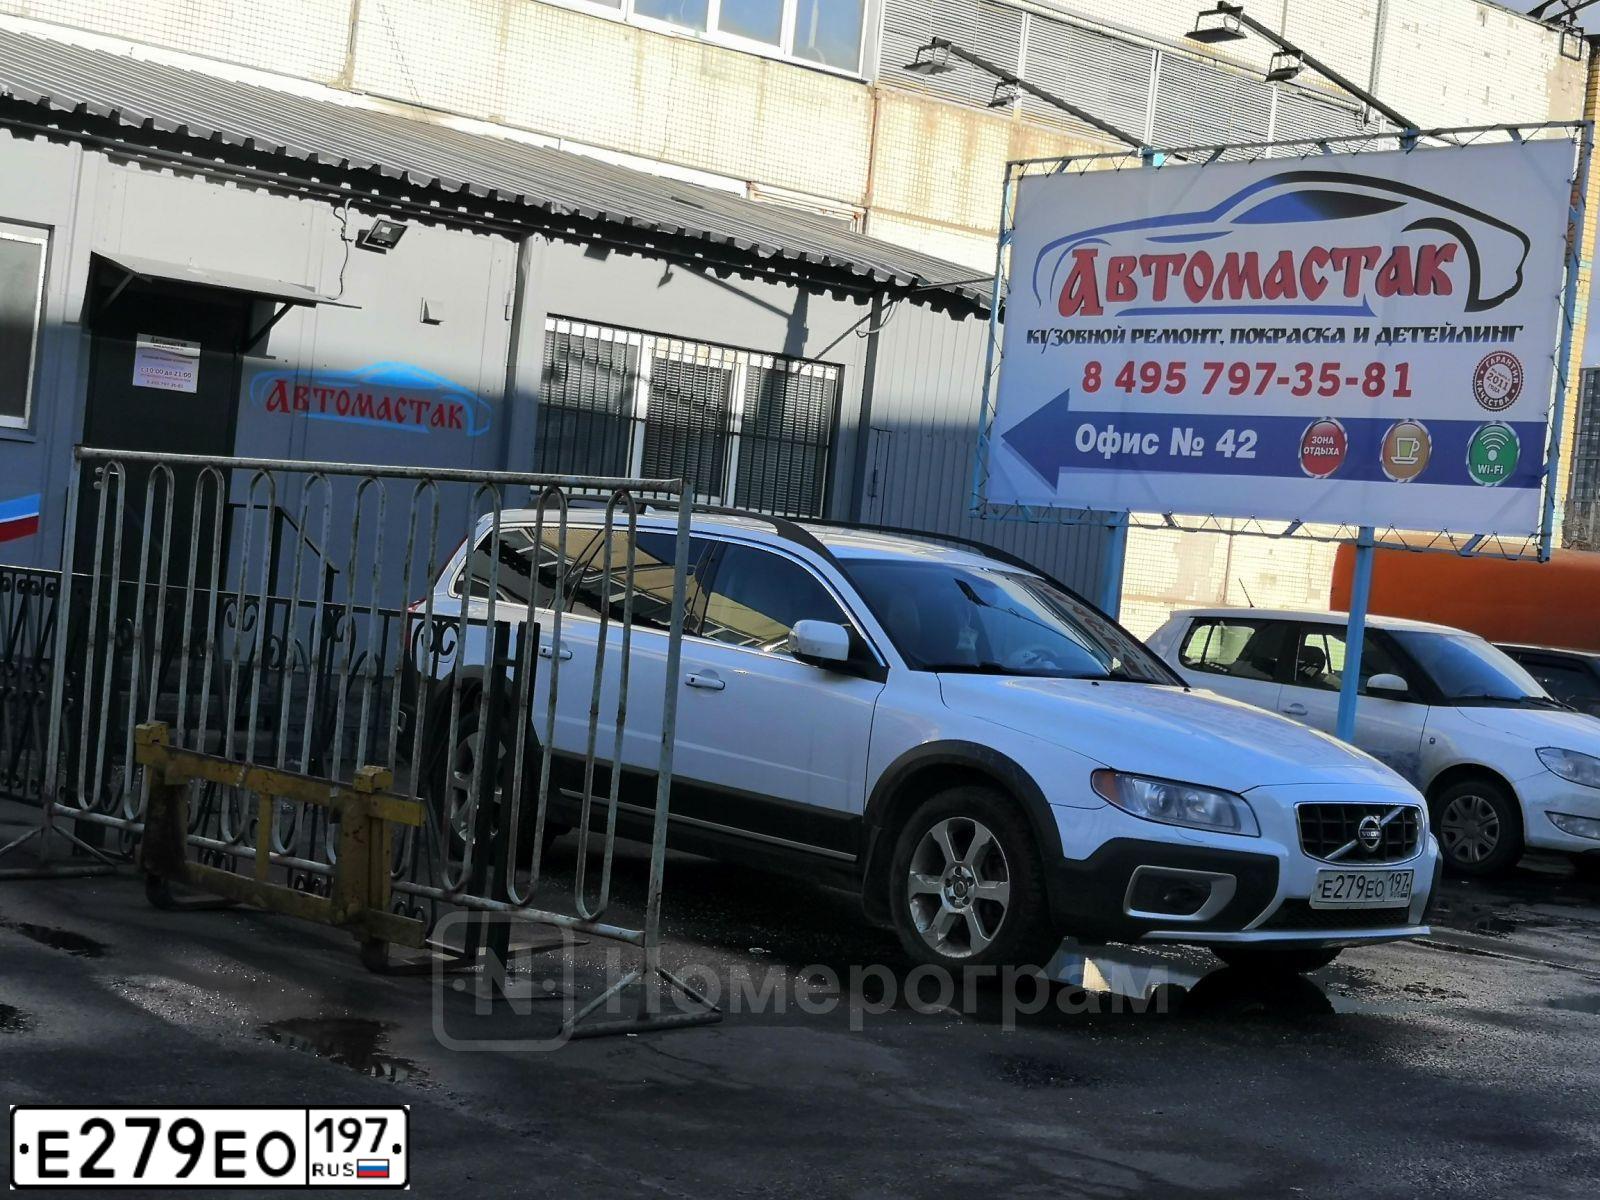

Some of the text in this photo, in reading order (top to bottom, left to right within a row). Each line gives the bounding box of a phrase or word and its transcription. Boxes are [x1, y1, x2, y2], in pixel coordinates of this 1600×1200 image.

[1058, 243, 1458, 316] Автомастак
[1026, 321, 1524, 353] КУЗОВНОЙ РЕМОНТ, ПОКРАСКА И ДЕТЕЙЛИНГ
[1082, 360, 1412, 398] 8 495 797-35-81
[1485, 356, 1519, 384] ГАРАНТИЯ
[1486, 372, 1508, 391] 2011
[266, 379, 464, 429] Автомастак
[1476, 380, 1510, 406] КАЧЕСТВА
[1075, 423, 1258, 459] Офис № 42
[1303, 446, 1340, 456] ОТДЫХА
[1311, 435, 1334, 445] ЗОНА
[1477, 464, 1504, 475] Wi-Fi
[1321, 872, 1410, 899] Е279ЕО 197
